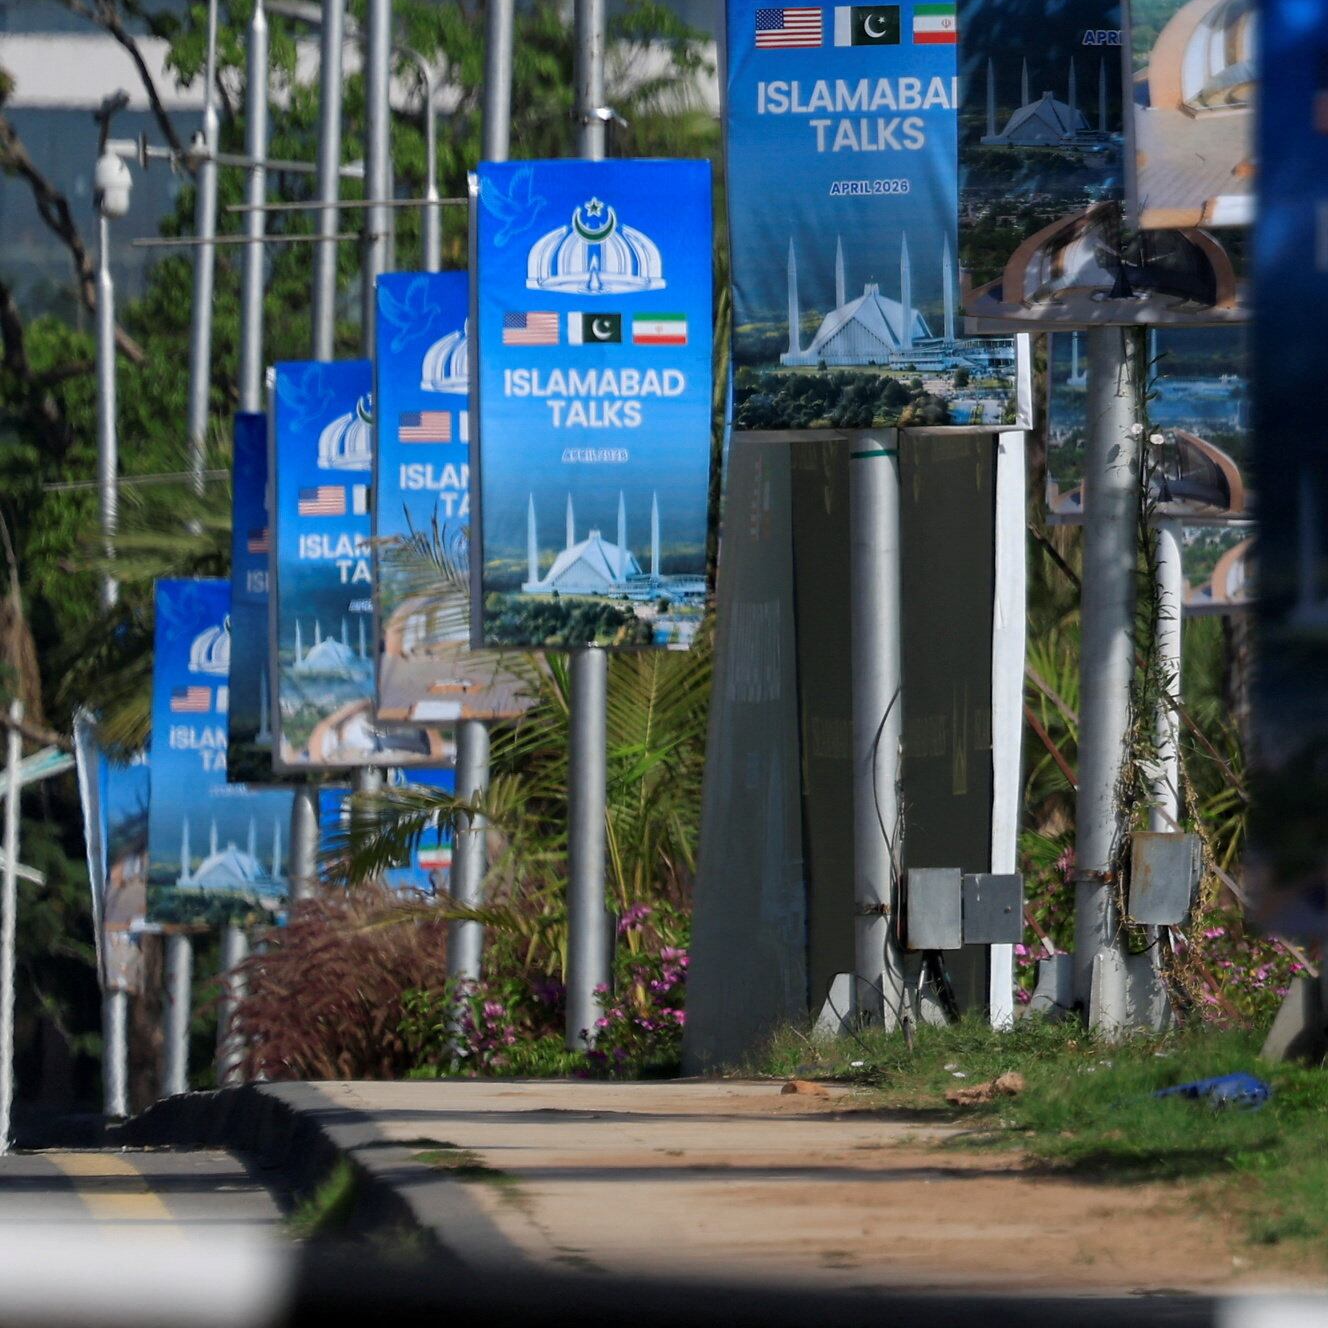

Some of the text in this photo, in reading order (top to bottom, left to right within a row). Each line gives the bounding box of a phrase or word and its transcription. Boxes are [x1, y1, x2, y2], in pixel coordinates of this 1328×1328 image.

[809, 116, 926, 153] TALKS
[830, 179, 910, 196] APRIL 2026
[504, 368, 686, 397] ISLAMABAD
[546, 400, 642, 428] TALKS
